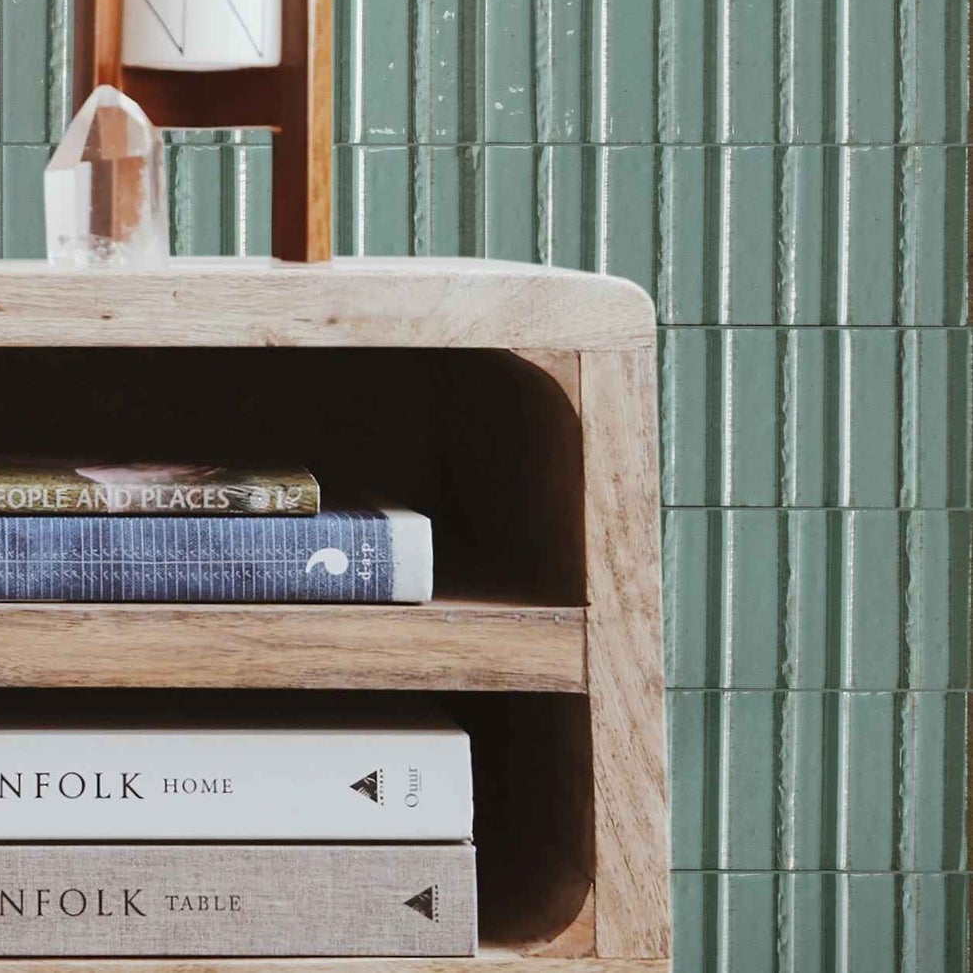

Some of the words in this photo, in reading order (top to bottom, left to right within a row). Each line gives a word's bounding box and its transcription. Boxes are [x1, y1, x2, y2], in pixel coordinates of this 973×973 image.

[77, 488, 132, 509] AND
[141, 487, 230, 509] PLACES
[163, 778, 233, 794] HOME
[165, 894, 241, 912] TABLE
